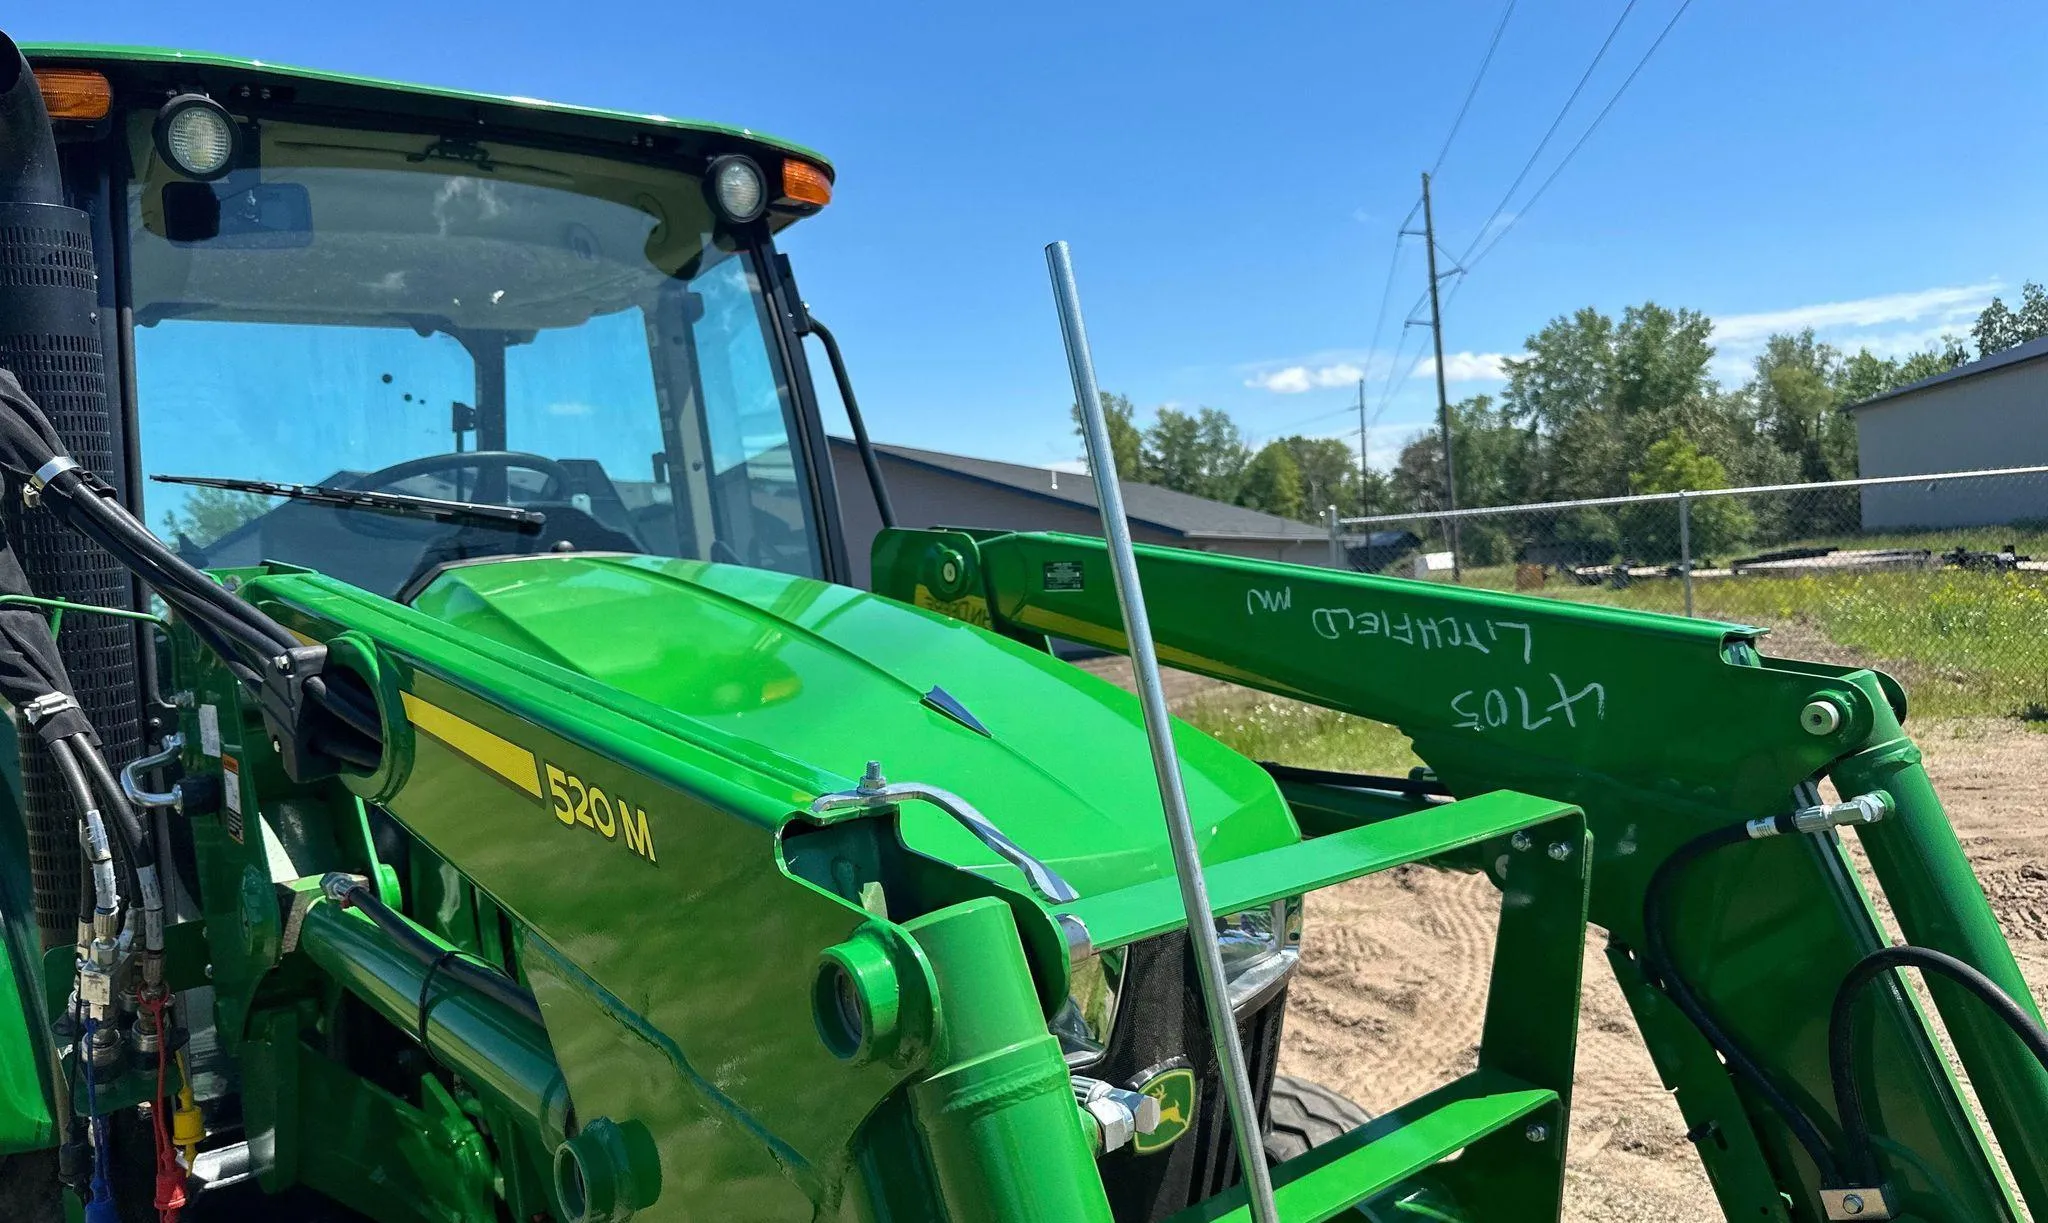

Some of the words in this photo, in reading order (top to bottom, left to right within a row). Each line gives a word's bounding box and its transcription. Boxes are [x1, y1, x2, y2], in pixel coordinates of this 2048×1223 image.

[1246, 586, 1291, 615] MN
[1312, 608, 1532, 665] LITCHFIELD
[1450, 672, 1605, 731] 4705
[545, 762, 616, 838] 520
[617, 799, 657, 862] M
